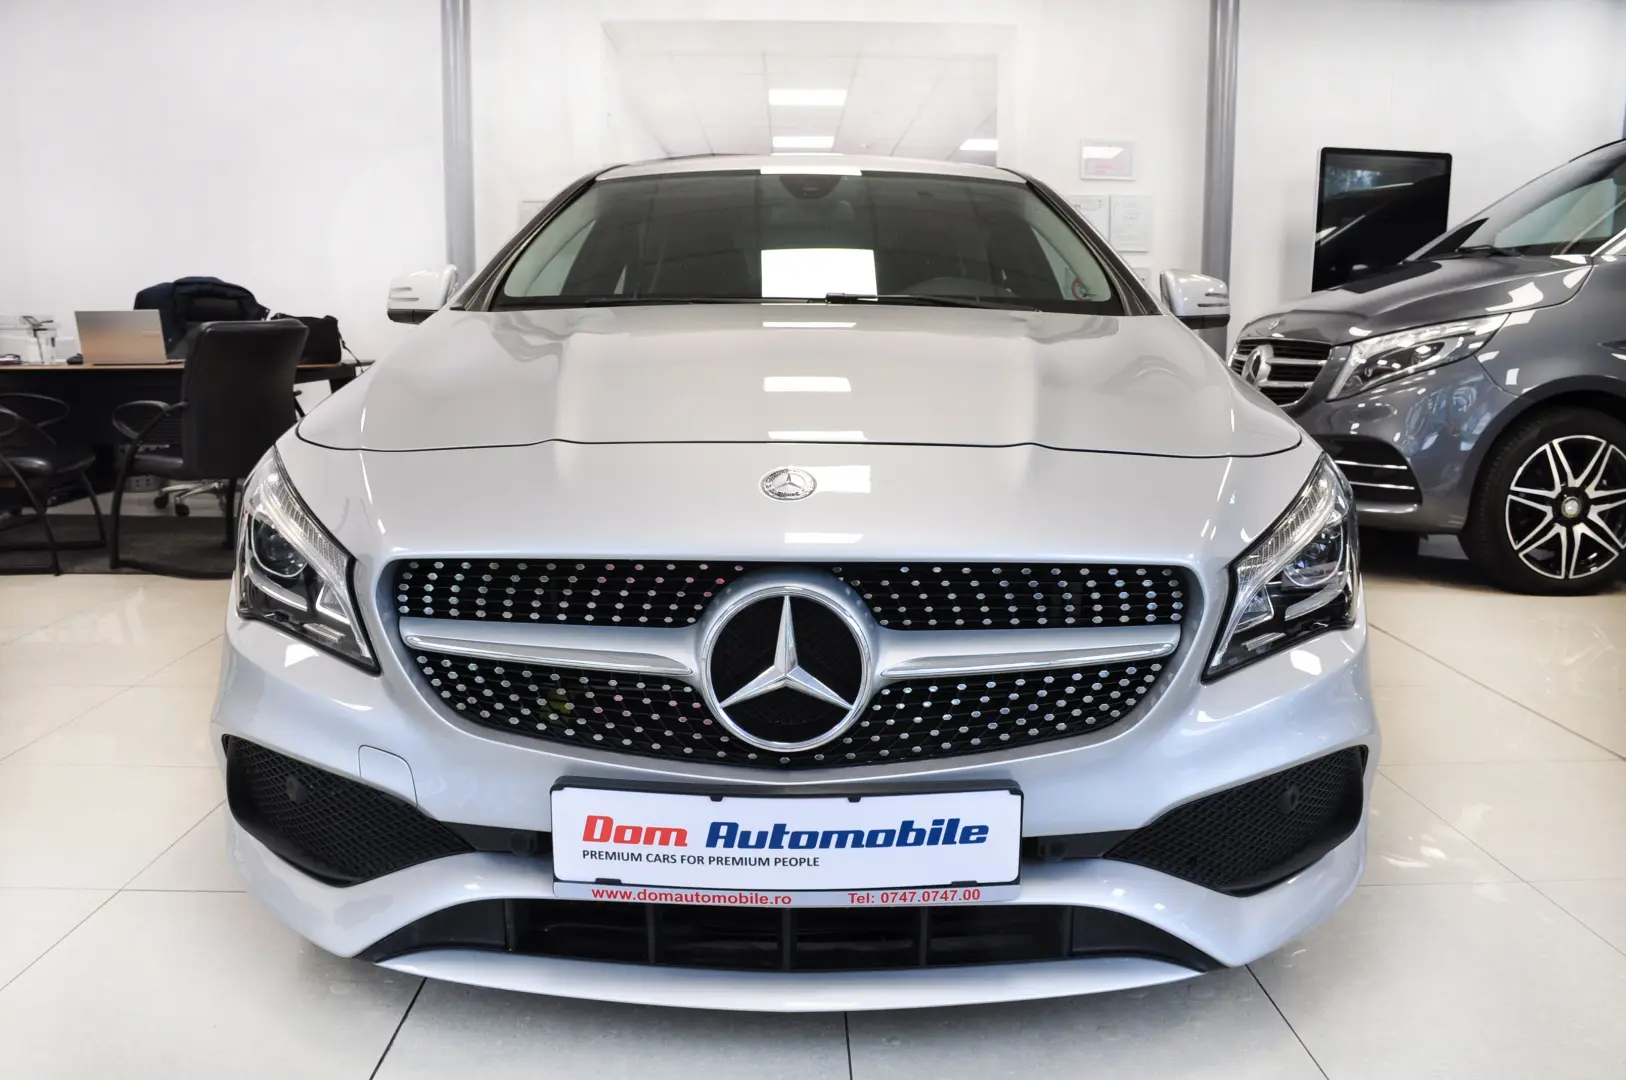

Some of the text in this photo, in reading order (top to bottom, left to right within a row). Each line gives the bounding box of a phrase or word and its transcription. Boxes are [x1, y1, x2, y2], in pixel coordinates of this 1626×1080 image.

[582, 814, 990, 850] Dom Automobile
[582, 849, 820, 867] PREMIUM CARS FOR PREMIUM PEOPLE
[591, 887, 793, 906] www.domautomobile.ro
[848, 888, 981, 905] Tel: 0747.0747.00
